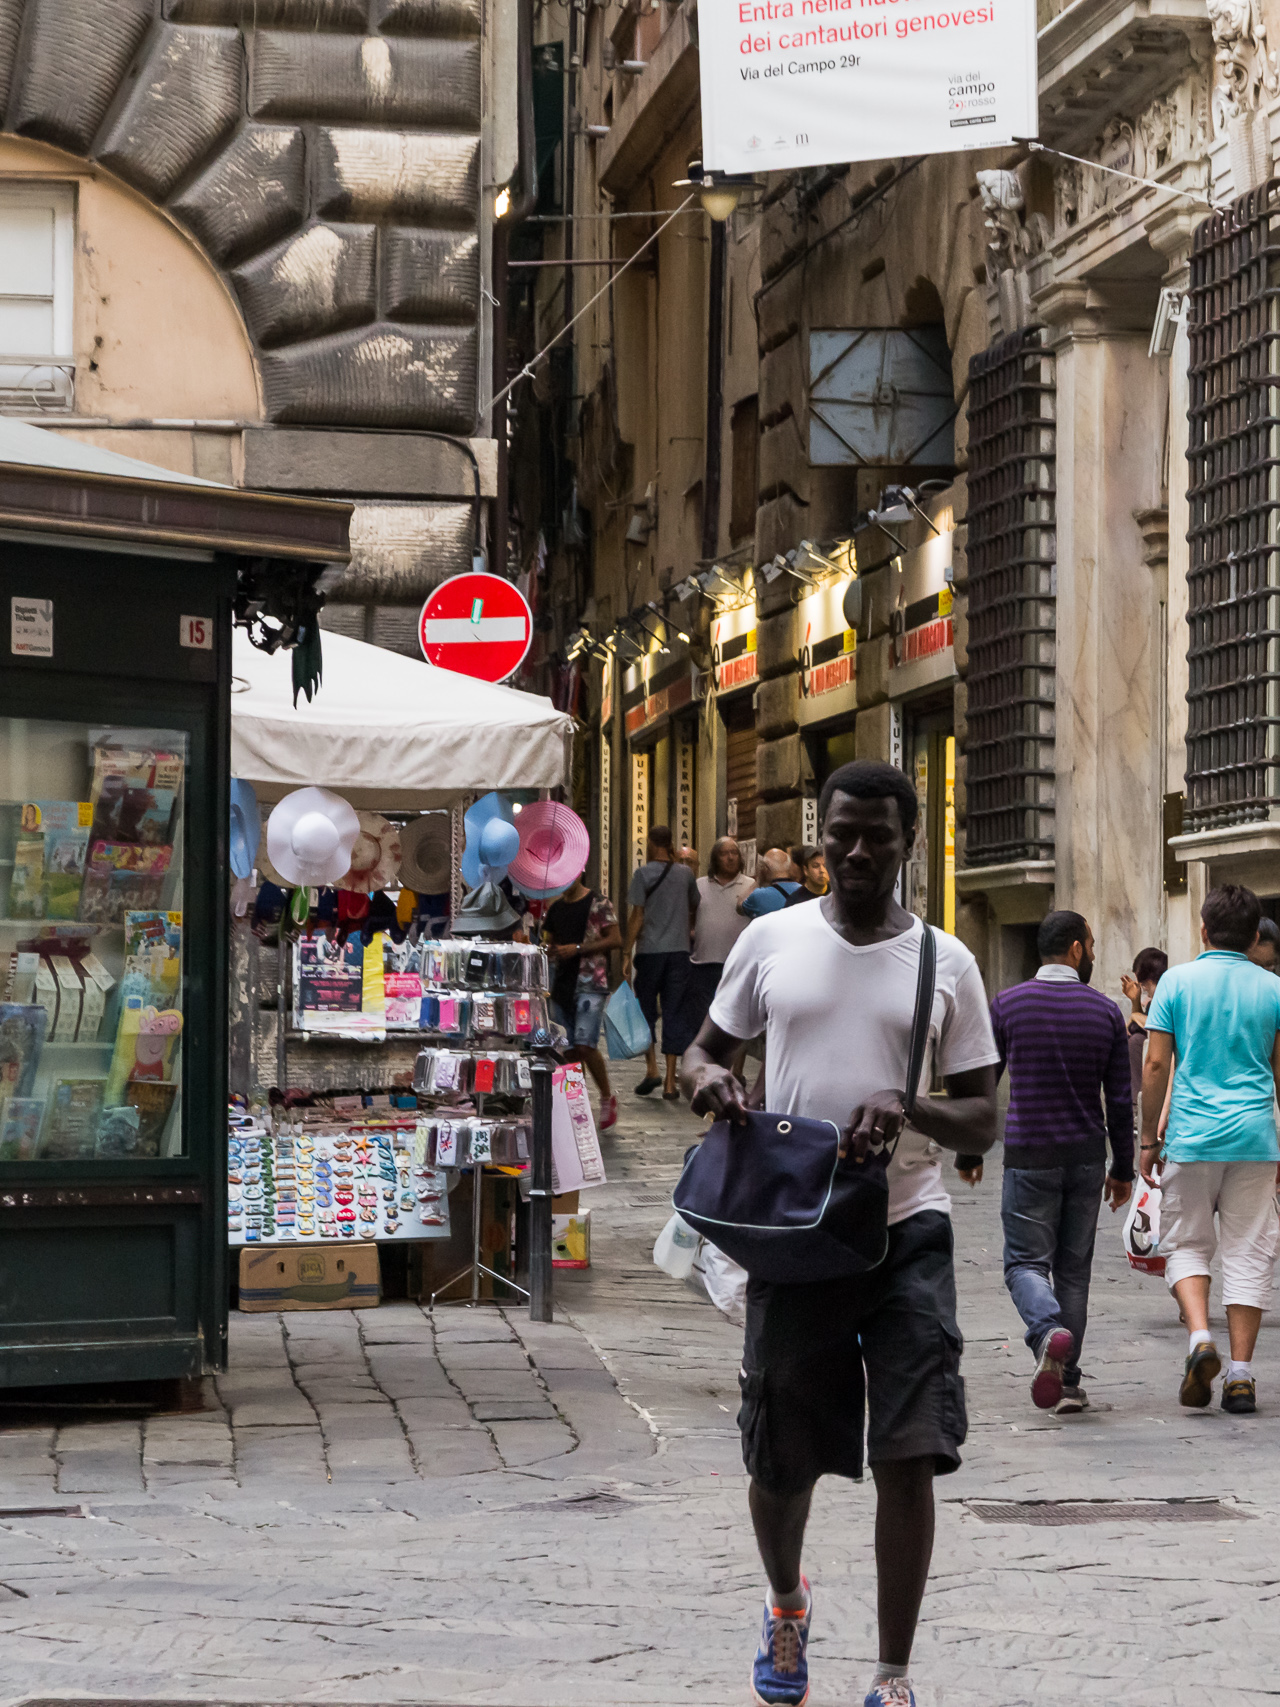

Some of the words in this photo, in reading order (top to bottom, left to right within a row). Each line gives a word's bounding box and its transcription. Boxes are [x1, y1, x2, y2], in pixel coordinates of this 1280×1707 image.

[739, 1, 794, 23] Entra
[739, 31, 771, 54] dei
[779, 16, 887, 49] cantautori
[895, 1, 994, 38] genovesi
[740, 67, 760, 81] Via
[764, 63, 784, 78] del
[788, 59, 836, 74] Campo
[840, 54, 861, 68] 29r
[948, 74, 963, 84] via
[965, 71, 981, 82] del
[948, 82, 995, 96] campo
[190, 620, 205, 644] 15
